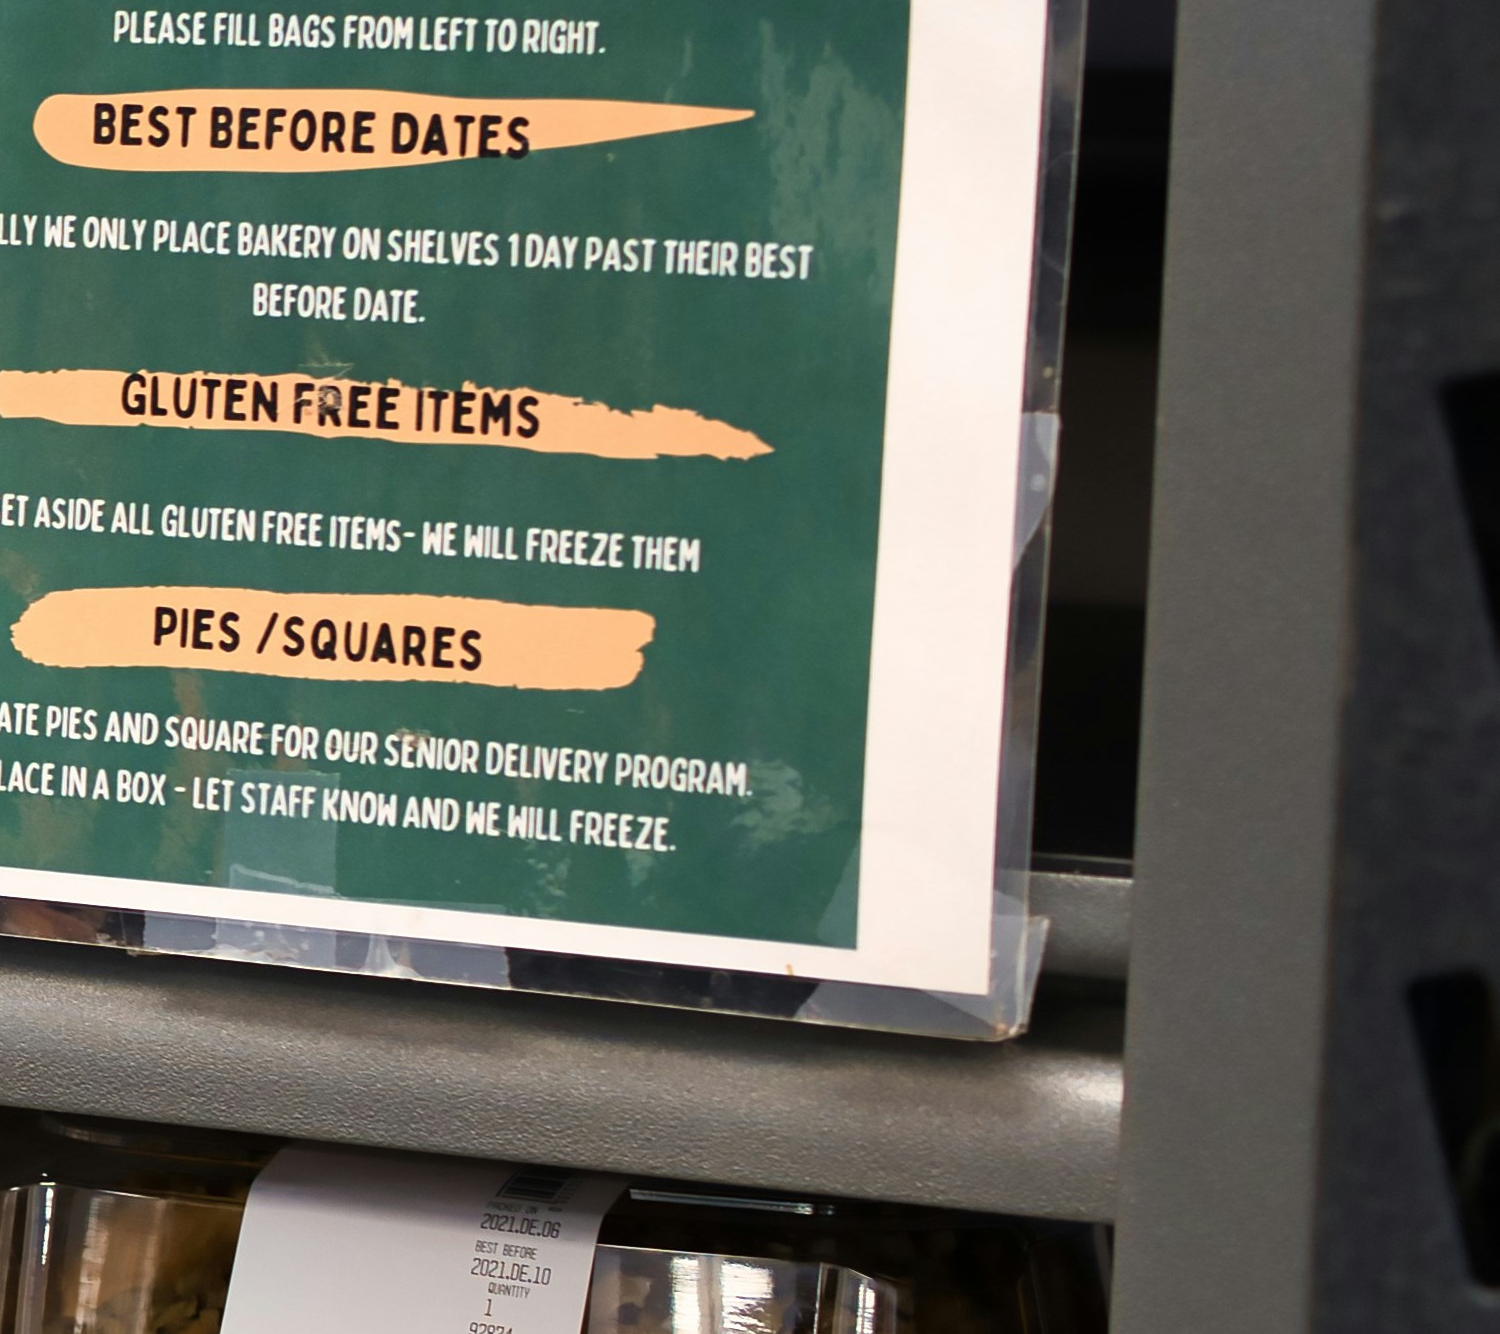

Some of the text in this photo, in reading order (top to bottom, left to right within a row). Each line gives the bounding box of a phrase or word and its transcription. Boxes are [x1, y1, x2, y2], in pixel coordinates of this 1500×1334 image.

[113, 10, 605, 55] PLEASE FILL BAGS FROM LEFT TO RIGHT.
[94, 103, 530, 162] BEST BEFORE DATES
[44, 214, 77, 249] WE
[82, 216, 147, 251] ONLY
[153, 219, 231, 255] PLACE
[237, 221, 337, 259] BAKERY
[342, 226, 381, 261] ON
[387, 229, 499, 266] SHELVES
[508, 233, 520, 267] 1
[524, 233, 578, 269] DAY
[584, 236, 656, 272] PAST
[663, 239, 738, 276] THEIR
[745, 242, 813, 279] BEST
[253, 282, 425, 324] BEFORE DATE.
[122, 371, 539, 438] GLUTEN FREE ITEMS
[33, 496, 106, 533] ASIDE
[110, 501, 154, 536] ALL
[161, 504, 256, 542] GLUTEN
[262, 510, 323, 547] FREE
[422, 521, 458, 557] WE
[463, 524, 519, 561] WILL
[525, 527, 624, 568] FREEZE
[631, 535, 700, 573] THEM
[155, 606, 239, 652] PIES
[45, 705, 98, 741] PIES
[103, 711, 159, 746] AND
[164, 716, 265, 756] SQUARE
[270, 723, 319, 760] FOR
[324, 728, 379, 765] OUR
[383, 734, 480, 773] SENIOR
[485, 741, 608, 784] DELIVERY
[615, 753, 753, 797] PROGRAM.
[61, 765, 88, 798] IN
[92, 768, 110, 800] A
[116, 769, 167, 806] BOX
[192, 776, 235, 812] LET
[240, 782, 317, 819] STAFF
[322, 788, 398, 827] KNOW
[402, 796, 460, 832] AND
[465, 801, 501, 837] WE
[507, 804, 562, 842] WILL
[569, 809, 677, 852] FREEZE.
[480, 1213, 561, 1238] 2021.DE.06
[470, 1258, 552, 1285] 2021.DE.10
[475, 1240, 537, 1260] BEST BEFORE
[484, 1298, 493, 1317] 1
[488, 1282, 531, 1299] QUANTITY
